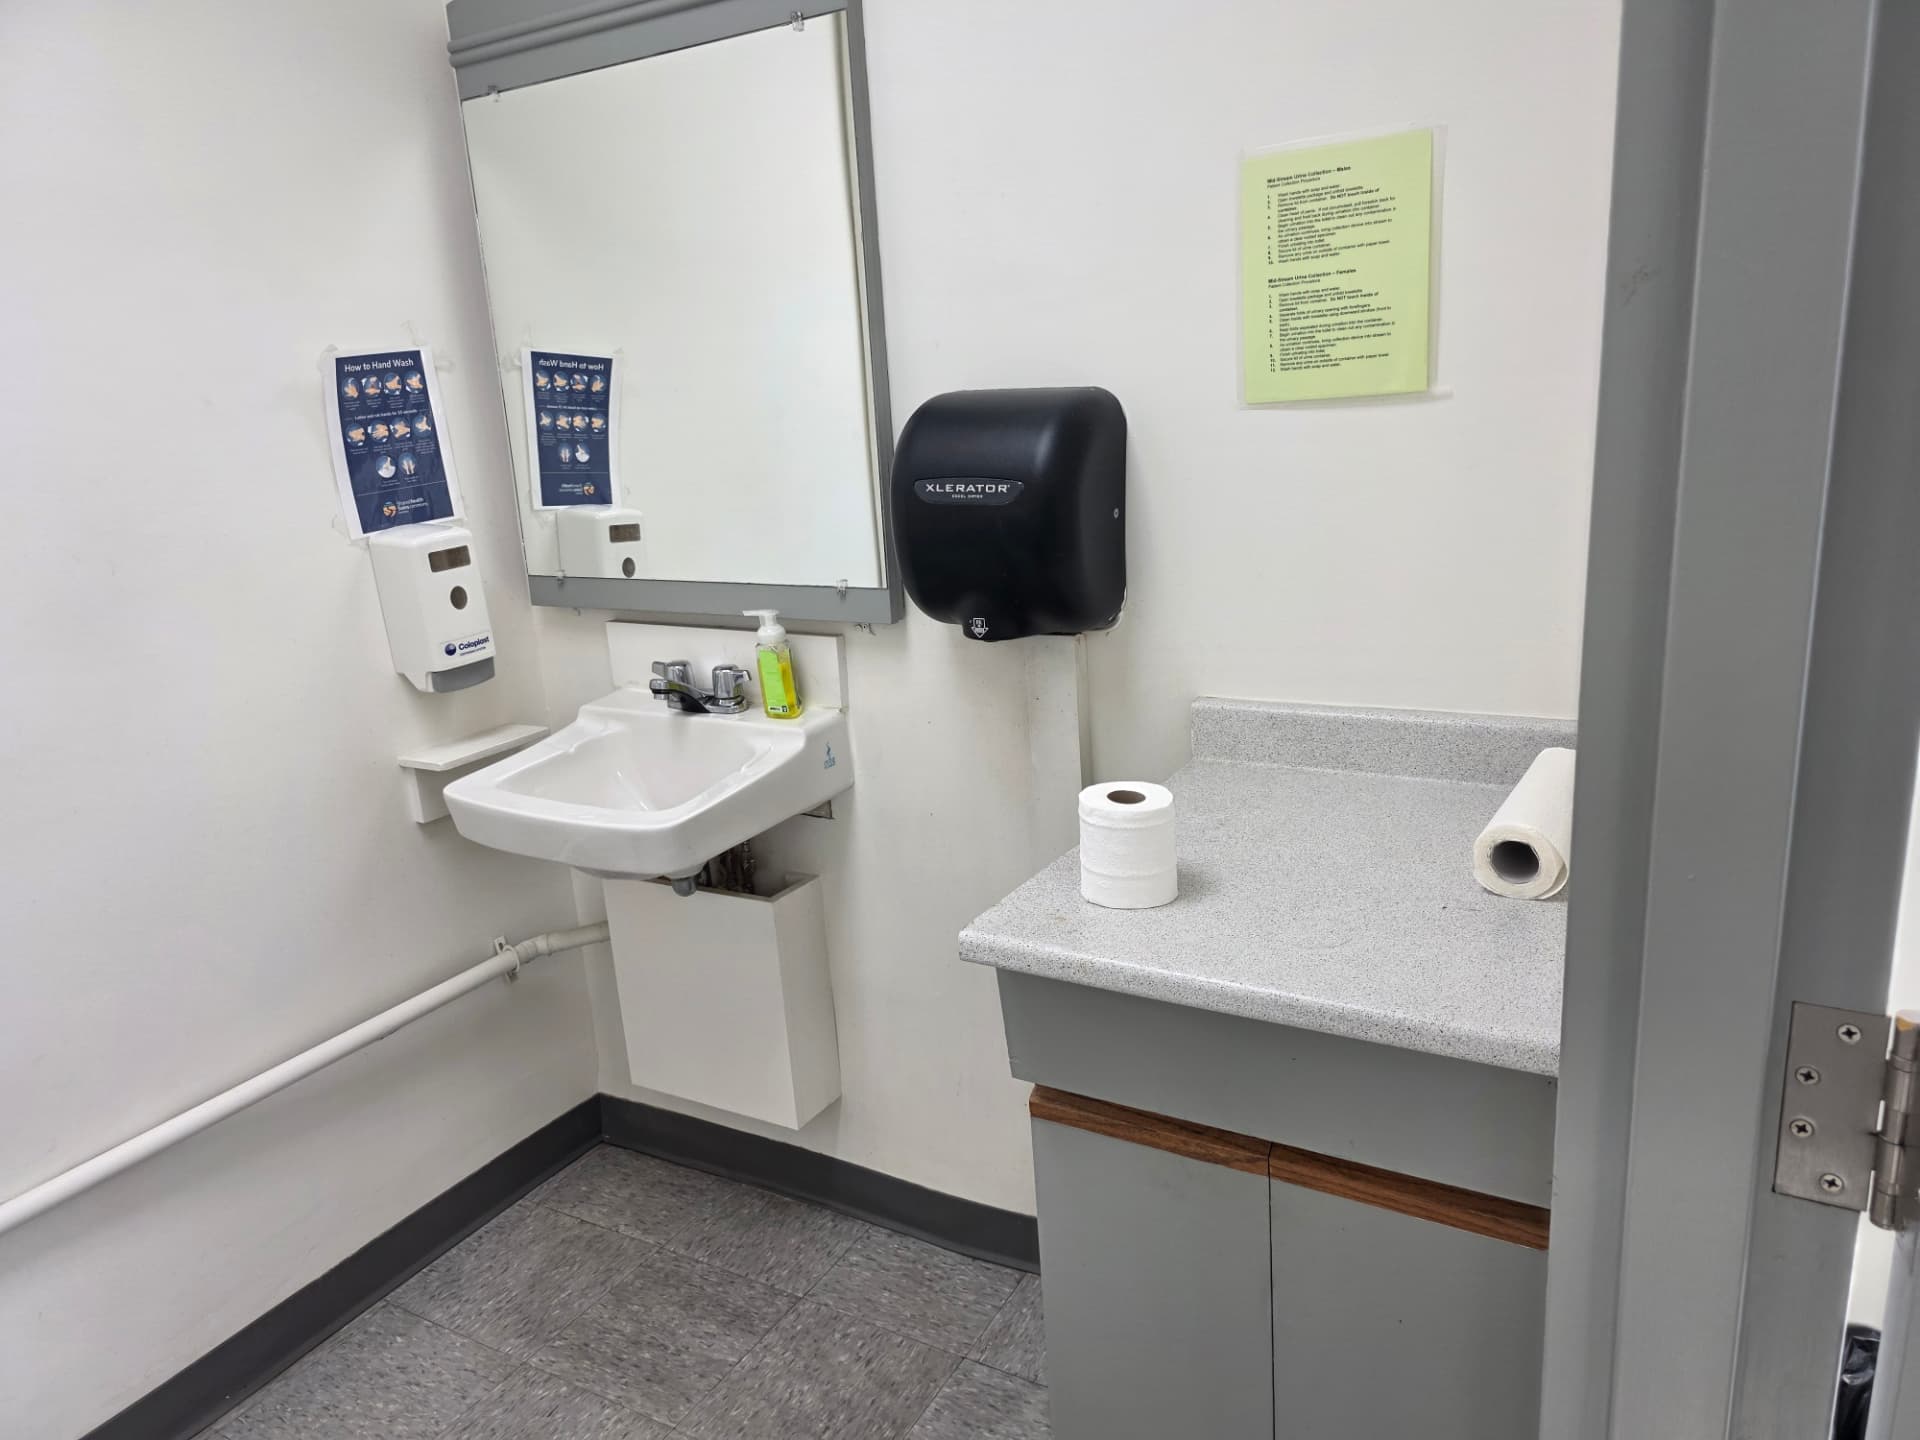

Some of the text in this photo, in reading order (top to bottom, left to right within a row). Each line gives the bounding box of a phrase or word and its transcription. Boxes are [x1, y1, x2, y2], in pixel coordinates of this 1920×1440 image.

[344, 364, 361, 373] How
[372, 360, 392, 369] Hand
[392, 358, 414, 367] Wash
[458, 636, 489, 650] Coloplast
